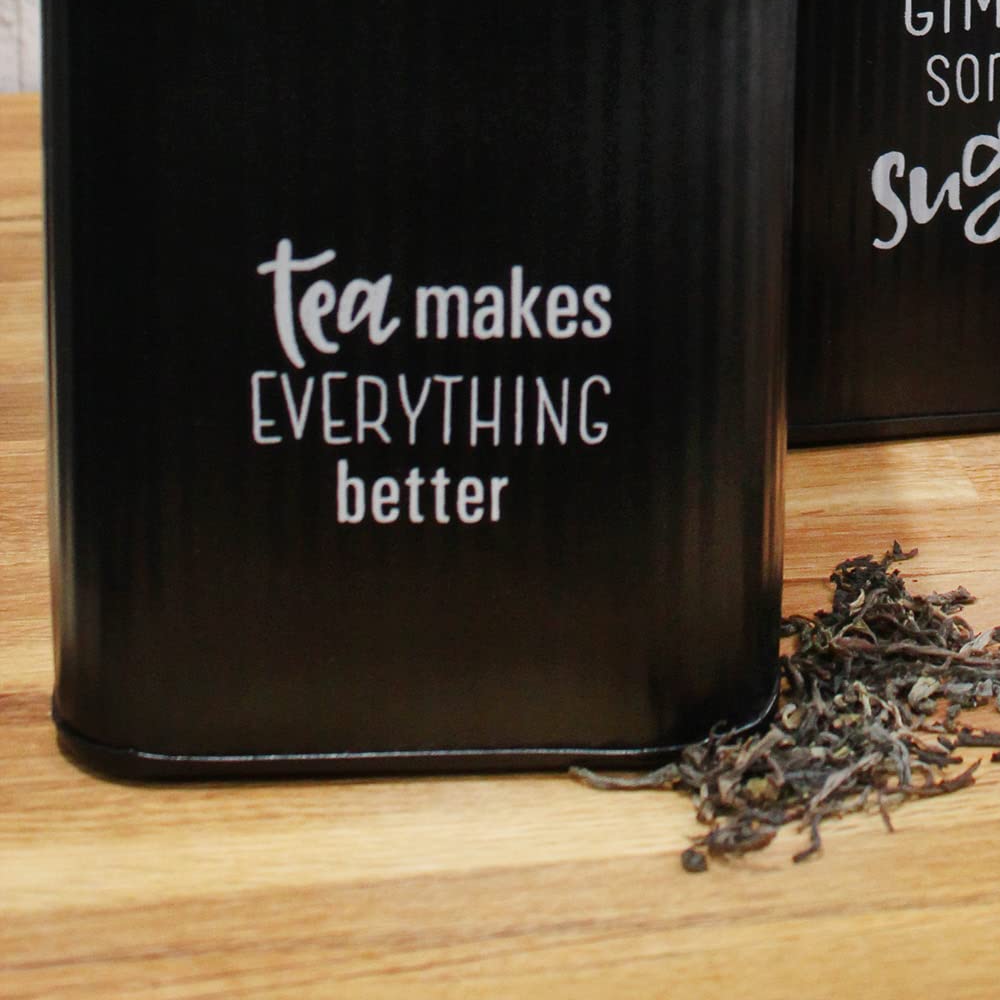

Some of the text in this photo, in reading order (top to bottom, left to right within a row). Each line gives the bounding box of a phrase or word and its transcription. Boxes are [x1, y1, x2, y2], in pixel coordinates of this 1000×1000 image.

[257, 238, 612, 369] tea makes
[251, 370, 612, 447] EVERYTHING
[337, 459, 509, 524] better
